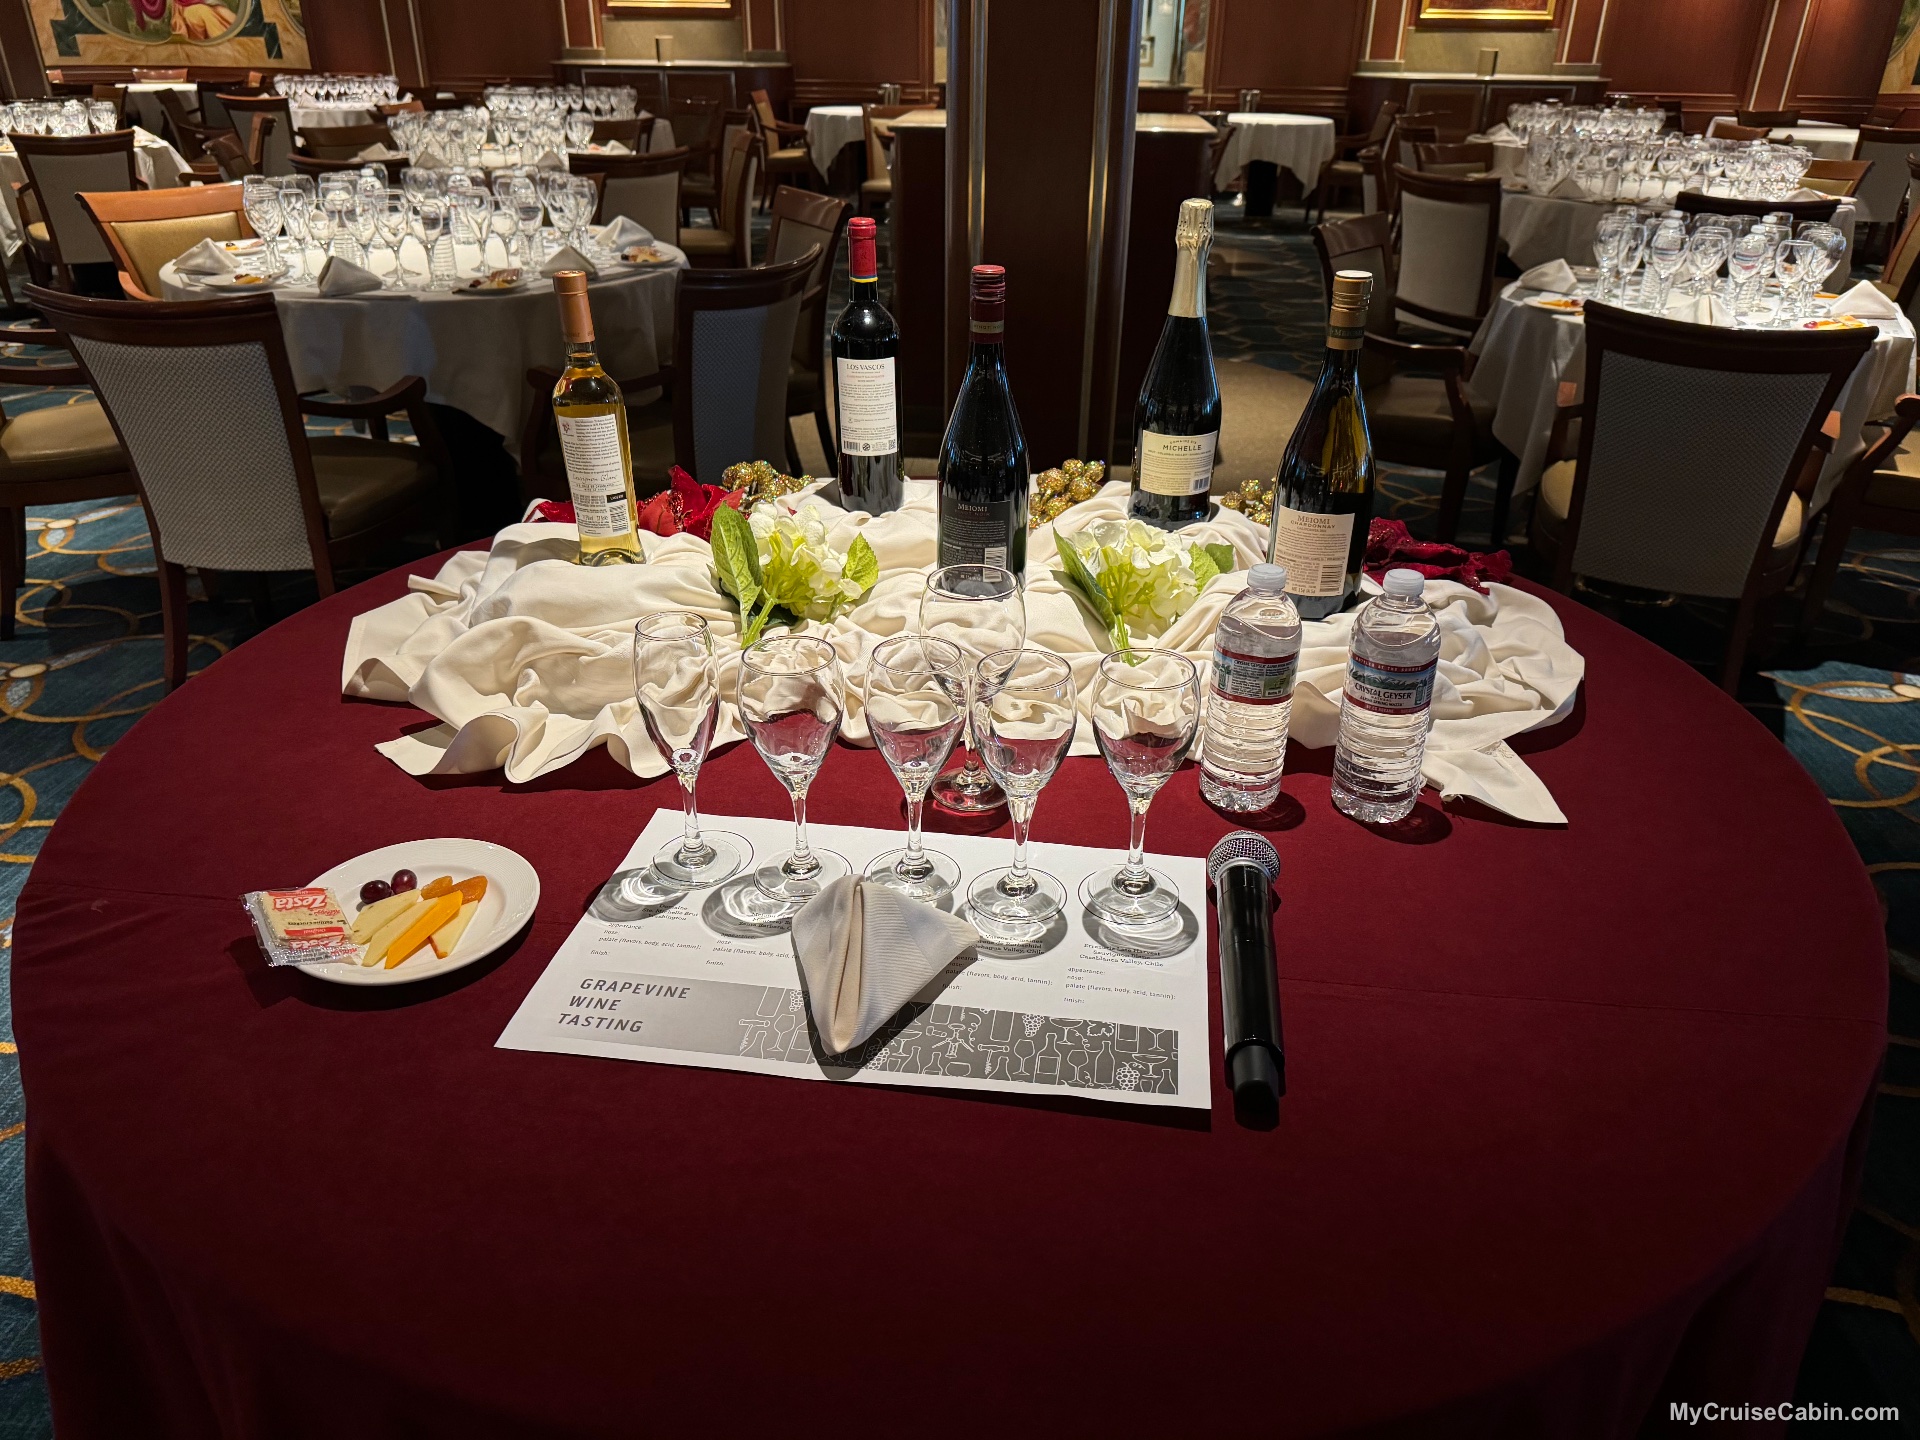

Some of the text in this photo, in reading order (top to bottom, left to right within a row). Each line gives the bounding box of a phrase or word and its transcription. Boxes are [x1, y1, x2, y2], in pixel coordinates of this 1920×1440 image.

[958, 504, 988, 512] MEIOMI
[1290, 520, 1336, 529] CHARDONNAY
[1298, 515, 1330, 524] MEIOMI
[1354, 682, 1412, 700] CRYSTAL GEYSER
[274, 894, 326, 910] Zesta
[290, 936, 344, 950] Zesta
[1080, 954, 1119, 963] Casablanca
[966, 970, 992, 978] (flavors,
[1027, 978, 1053, 986] tannin):
[1067, 968, 1106, 976] appearance:
[580, 978, 690, 999] GRAPEVINE
[569, 996, 621, 1010] WINE
[1150, 992, 1176, 1000] tannin):
[558, 1013, 643, 1032] TASTING
